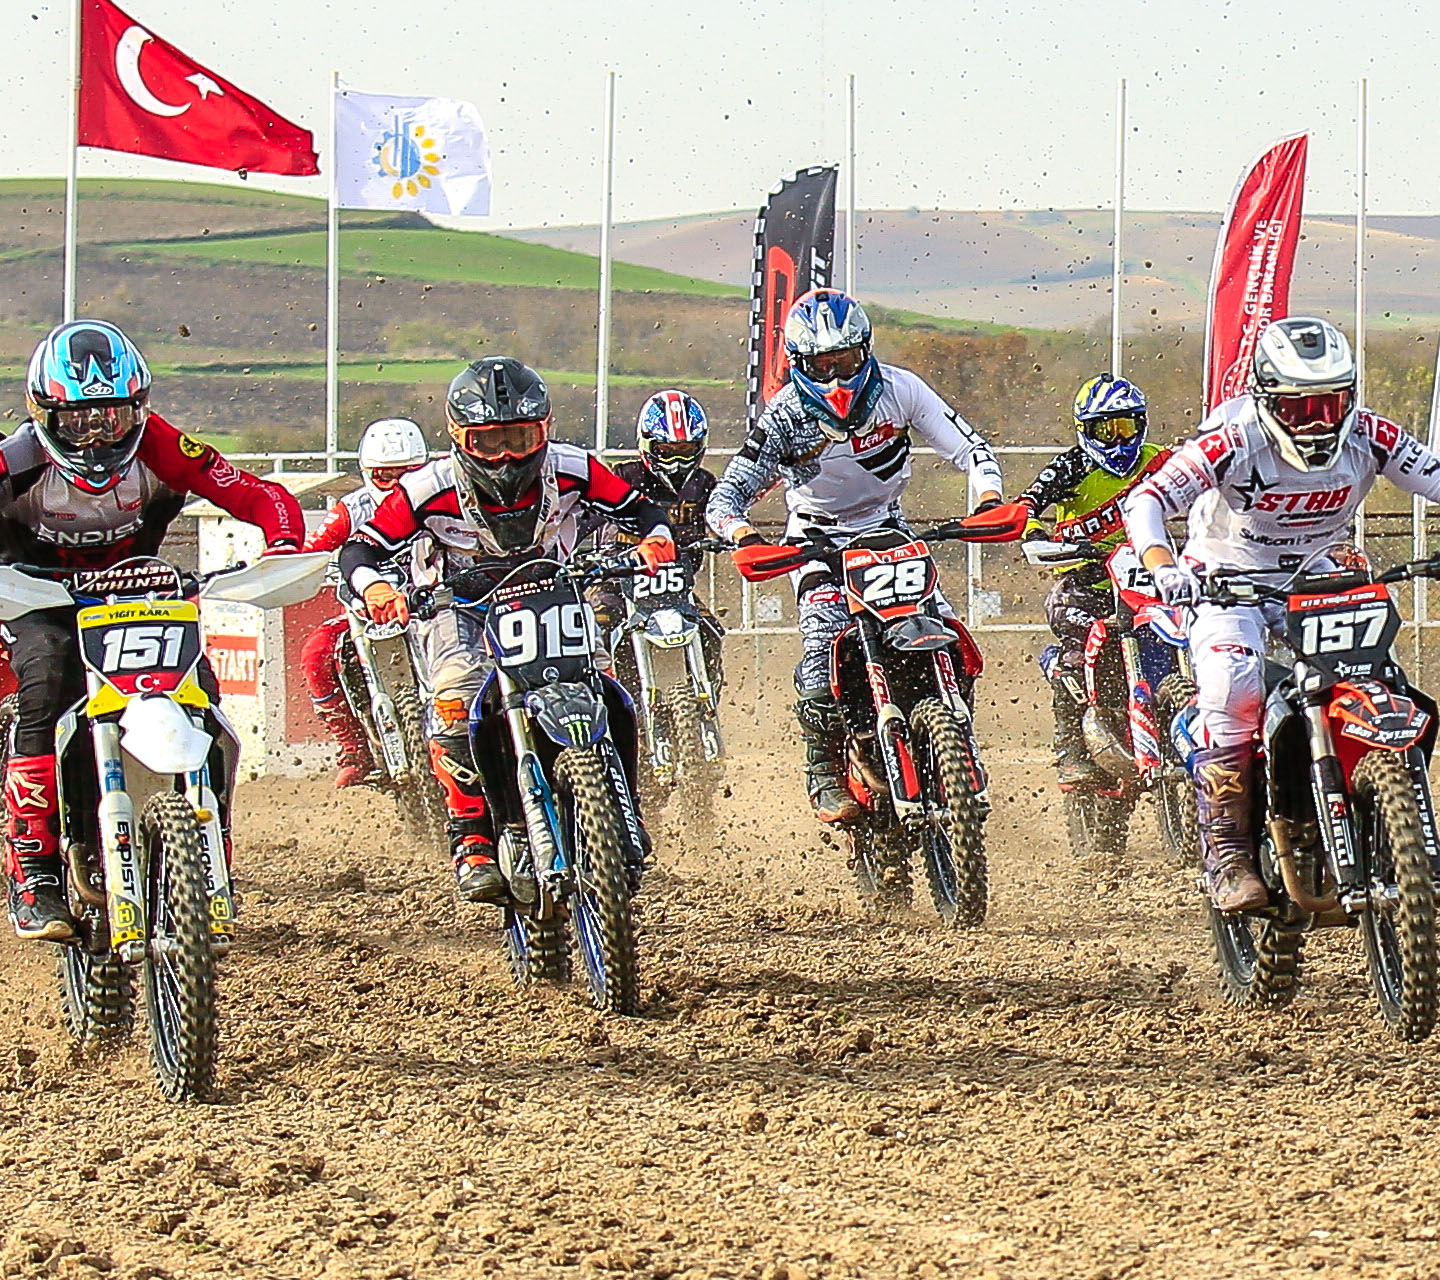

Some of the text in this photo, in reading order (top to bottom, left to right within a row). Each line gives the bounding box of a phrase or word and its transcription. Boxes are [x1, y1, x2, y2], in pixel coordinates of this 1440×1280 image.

[1253, 219, 1267, 240] VE
[1256, 307, 1272, 339] POR
[1254, 485, 1352, 513] STAR
[633, 568, 685, 598] 205
[863, 560, 927, 602] 28
[102, 626, 186, 671] 151
[498, 602, 596, 667] 919
[1301, 607, 1389, 657] 157
